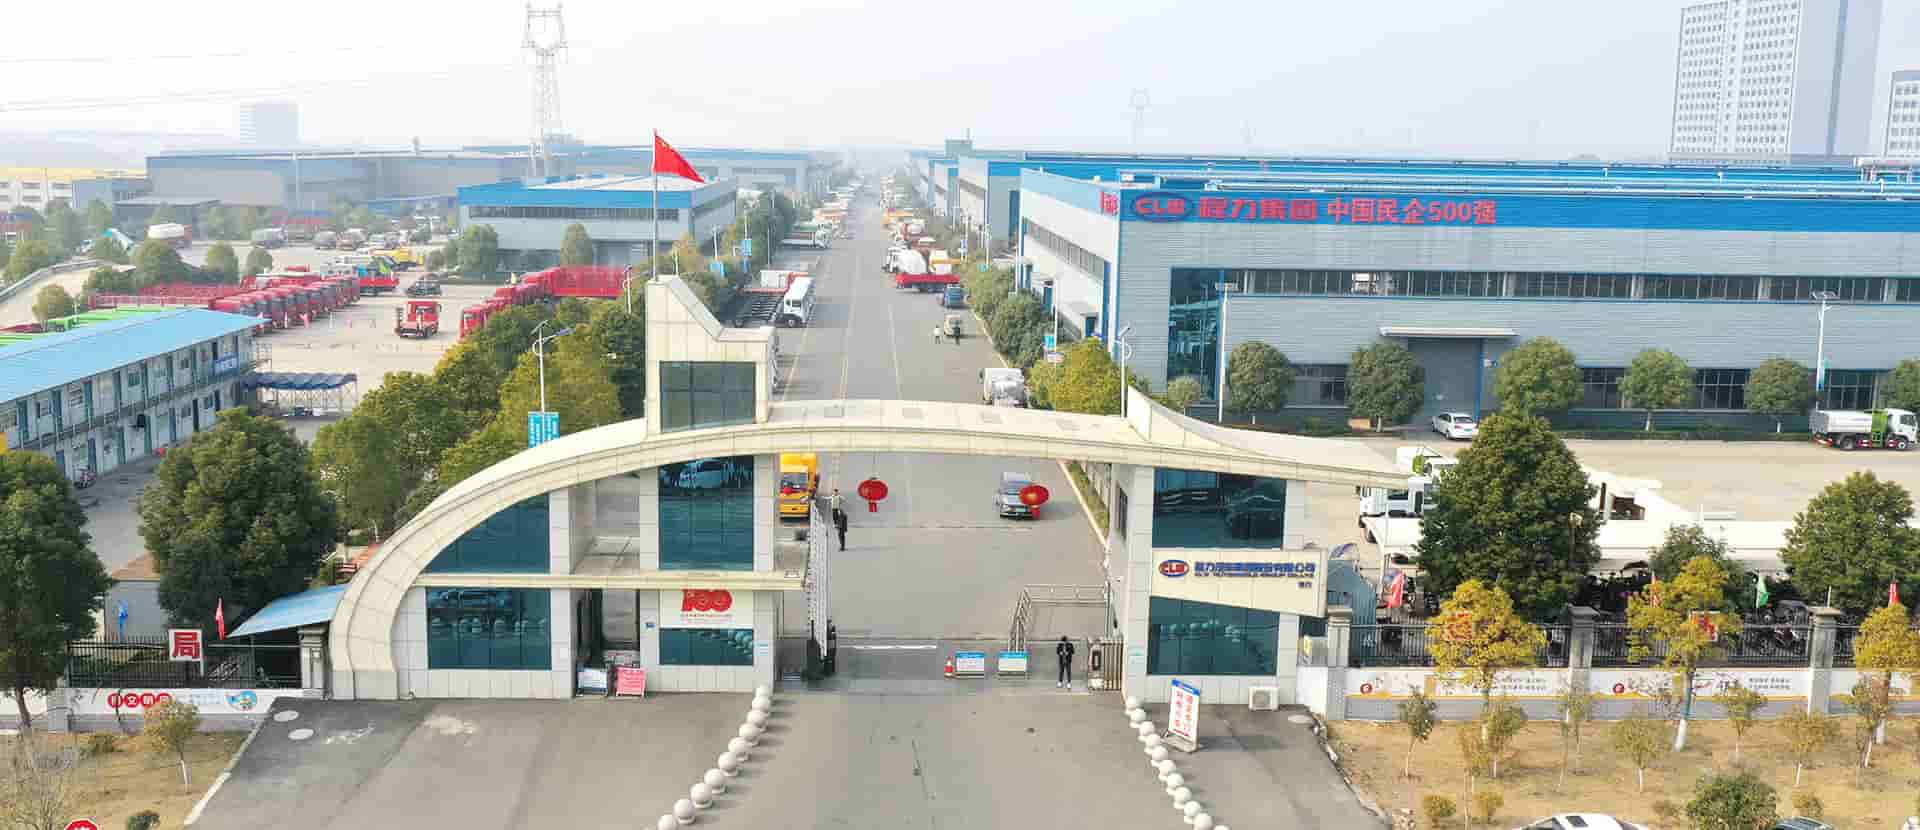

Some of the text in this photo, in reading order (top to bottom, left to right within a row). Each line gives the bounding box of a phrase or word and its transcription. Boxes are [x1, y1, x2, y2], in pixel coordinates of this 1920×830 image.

[1328, 197, 1496, 225] 中国民企500强
[172, 631, 200, 658] 局
